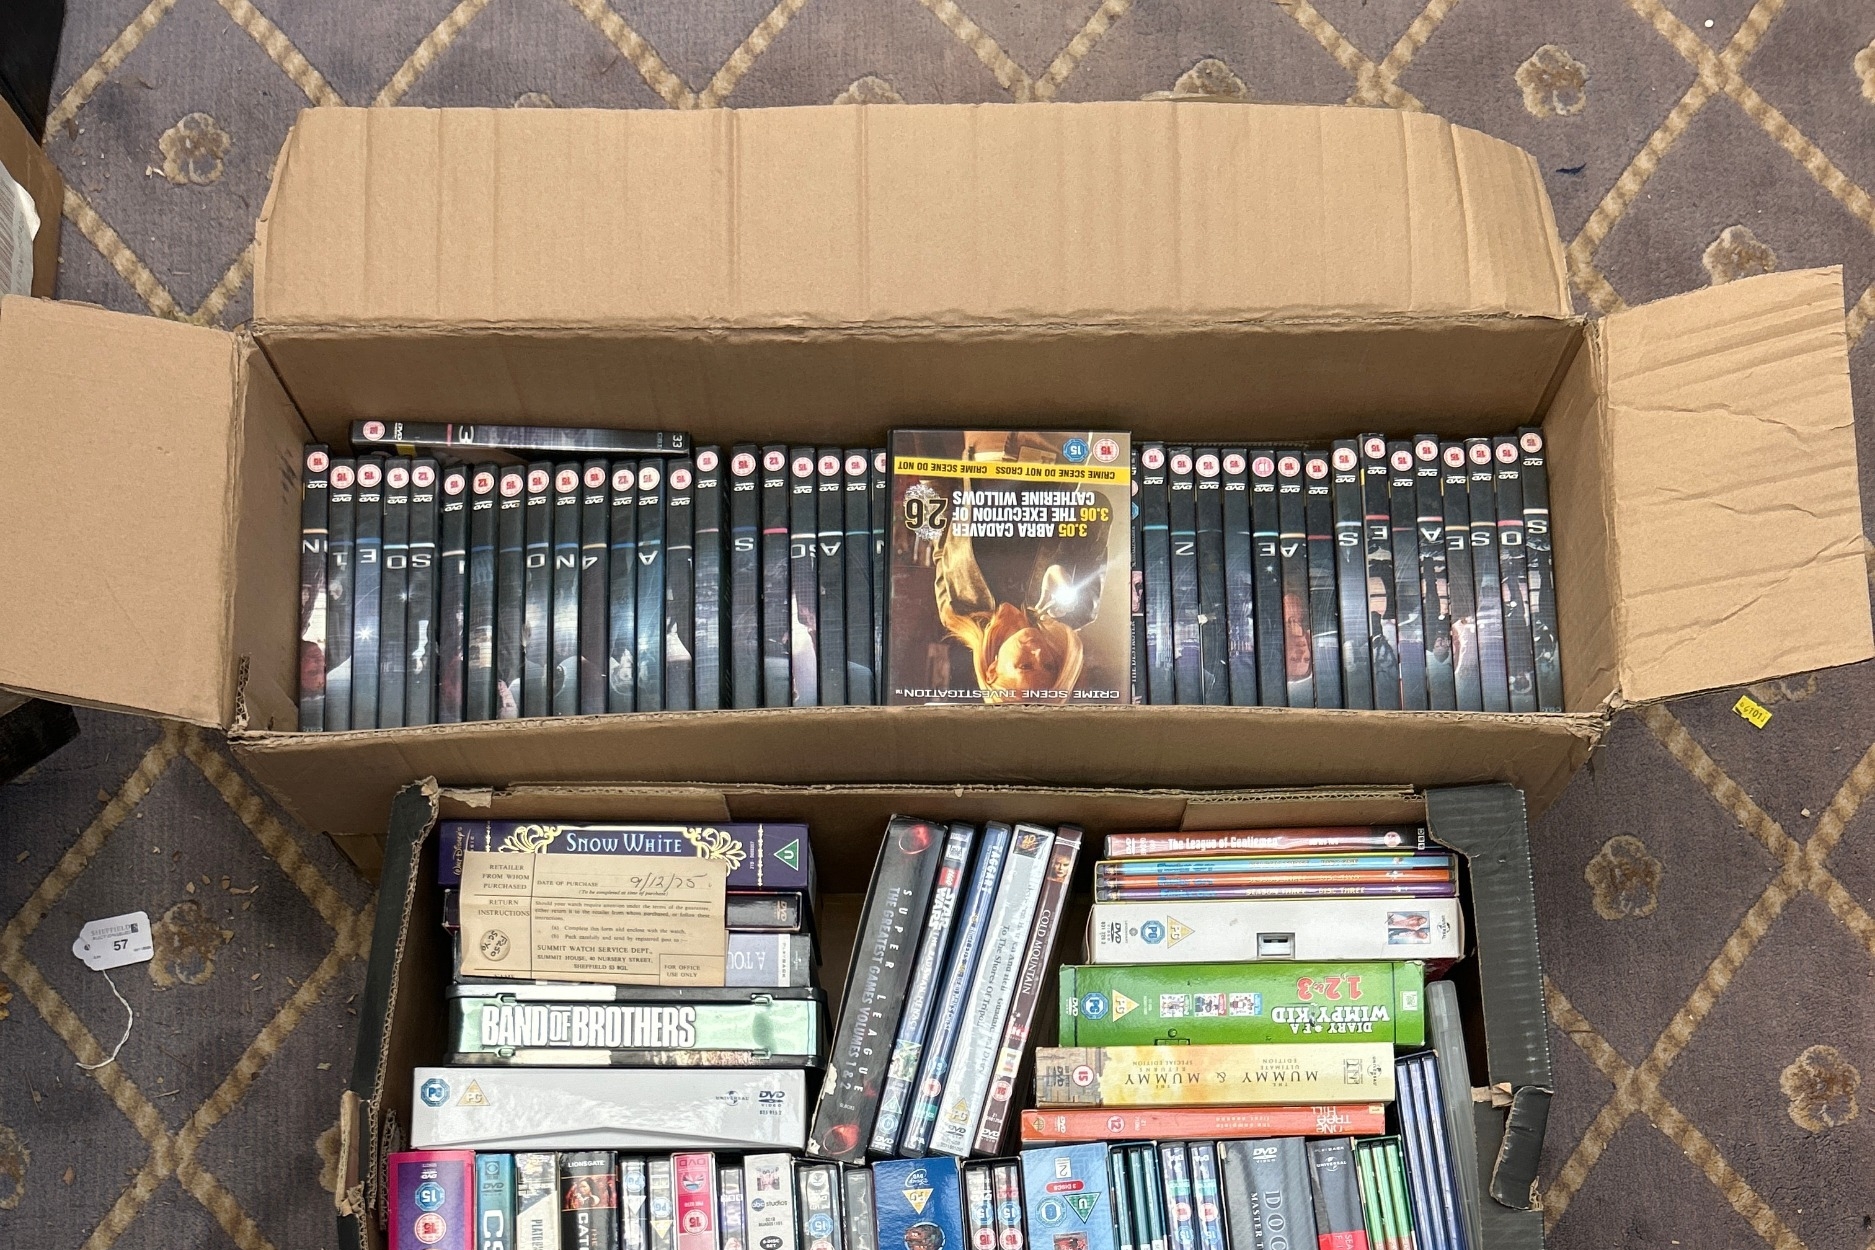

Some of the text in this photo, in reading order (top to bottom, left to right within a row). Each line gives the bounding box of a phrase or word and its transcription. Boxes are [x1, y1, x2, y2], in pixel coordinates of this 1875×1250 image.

[898, 461, 987, 473] CRIME SCENE DO NOT
[995, 466, 1115, 479] CRIME SCENE DO NOT CROSS
[953, 491, 1095, 505] CATHERINE WILLOWS
[905, 498, 949, 530] 26
[953, 508, 1108, 521] 3.06 THE EXECUTION OF
[953, 524, 1087, 537] 3.05 ABRA CADAVER
[1022, 690, 1068, 699] SCENE
[1073, 690, 1120, 698] CRIME
[1168, 838, 1189, 850] The
[1190, 837, 1216, 852] League
[1218, 837, 1227, 849] of
[114, 939, 128, 951] 57
[1021, 909, 1051, 995] COLD MOUNTAIN
[1271, 1005, 1391, 1023] WIMPY KID
[481, 1004, 696, 1048] BAND OF BROTHERS
[1327, 1022, 1374, 1034] DIARY
[1124, 1072, 1200, 1085] MUMMY
[1242, 1070, 1319, 1083] MUMMY
